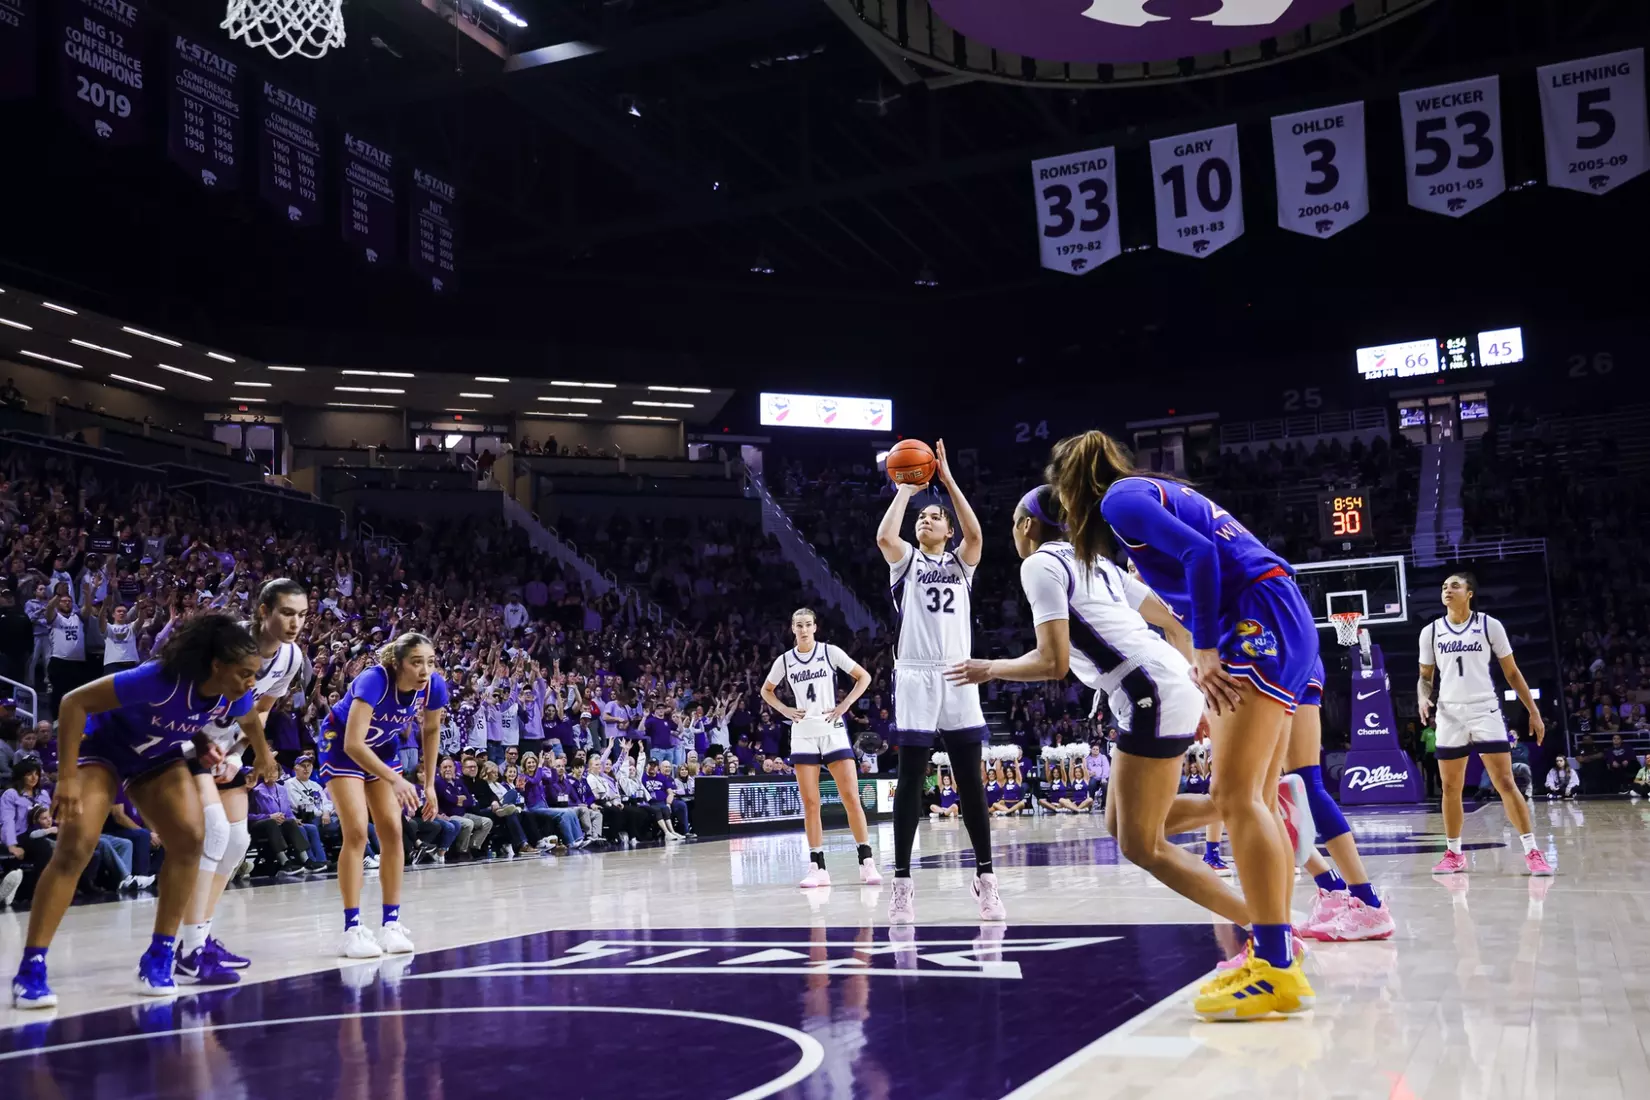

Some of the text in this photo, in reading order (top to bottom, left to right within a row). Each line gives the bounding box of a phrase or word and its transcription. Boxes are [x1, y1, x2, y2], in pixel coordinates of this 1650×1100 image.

[0, 9, 19, 27] 023
[83, 17, 124, 48] BIG 12
[66, 26, 142, 72] CONFERENCE
[176, 35, 237, 78] K-STATE
[65, 40, 143, 89] CHAMPIONS
[183, 68, 232, 100] CONFERENCE
[1552, 63, 1630, 88] LEHNING
[77, 75, 131, 118] 2019
[176, 75, 239, 112] CHAMPIONSHIPS
[264, 80, 316, 119] K-STATE
[1416, 90, 1483, 112] WECKER
[184, 97, 204, 114] 1917
[184, 111, 204, 127] 1919
[213, 111, 231, 127] 1951
[271, 112, 314, 140] CONFERENCE
[1292, 114, 1345, 135] OHLDE
[1576, 88, 1616, 150] 5
[184, 124, 204, 140] 1948
[212, 124, 233, 140] 1956
[264, 118, 319, 152] CHAMPIONSHIPS
[184, 137, 205, 154] 1950
[213, 137, 233, 153] 1958
[273, 138, 290, 154] 1960
[345, 132, 392, 167] K-STATE
[1173, 139, 1214, 157] GARY
[1415, 110, 1494, 177] 53
[213, 150, 234, 165] 1959
[273, 151, 290, 166] 1961
[1569, 154, 1628, 173] 2005-09
[274, 163, 291, 178] 1963
[298, 163, 315, 178] 1970
[1040, 158, 1108, 180] ROMSTAD
[1302, 138, 1340, 196] 3
[274, 175, 291, 191] 1964
[299, 174, 315, 190] 1972
[414, 168, 455, 200] K-STATE
[1161, 157, 1233, 219] 10
[1429, 178, 1483, 196] 2001-05
[300, 186, 316, 201] 1973
[1042, 178, 1111, 238] 33
[1298, 200, 1350, 218] 2000-04
[1177, 220, 1225, 238] 1981-83
[1056, 241, 1102, 256] 1979-82
[1488, 342, 1512, 357] 45
[1405, 353, 1428, 369] 66
[1566, 352, 1613, 378] 26
[1282, 388, 1322, 411] 25
[1015, 420, 1051, 443] 24
[1334, 497, 1362, 511] 8:54
[1332, 510, 1360, 535] 30
[917, 569, 962, 586] Wildcats
[926, 587, 955, 613] 32
[65, 630, 78, 640] 25
[1255, 638, 1266, 646] KU
[1438, 640, 1483, 654] Wildcats
[1456, 656, 1463, 677] 1
[790, 668, 828, 684] Wildcats
[806, 683, 816, 702] 4
[151, 715, 204, 733] KANS
[1357, 727, 1389, 735] Channel
[1344, 766, 1408, 789] Dillons
